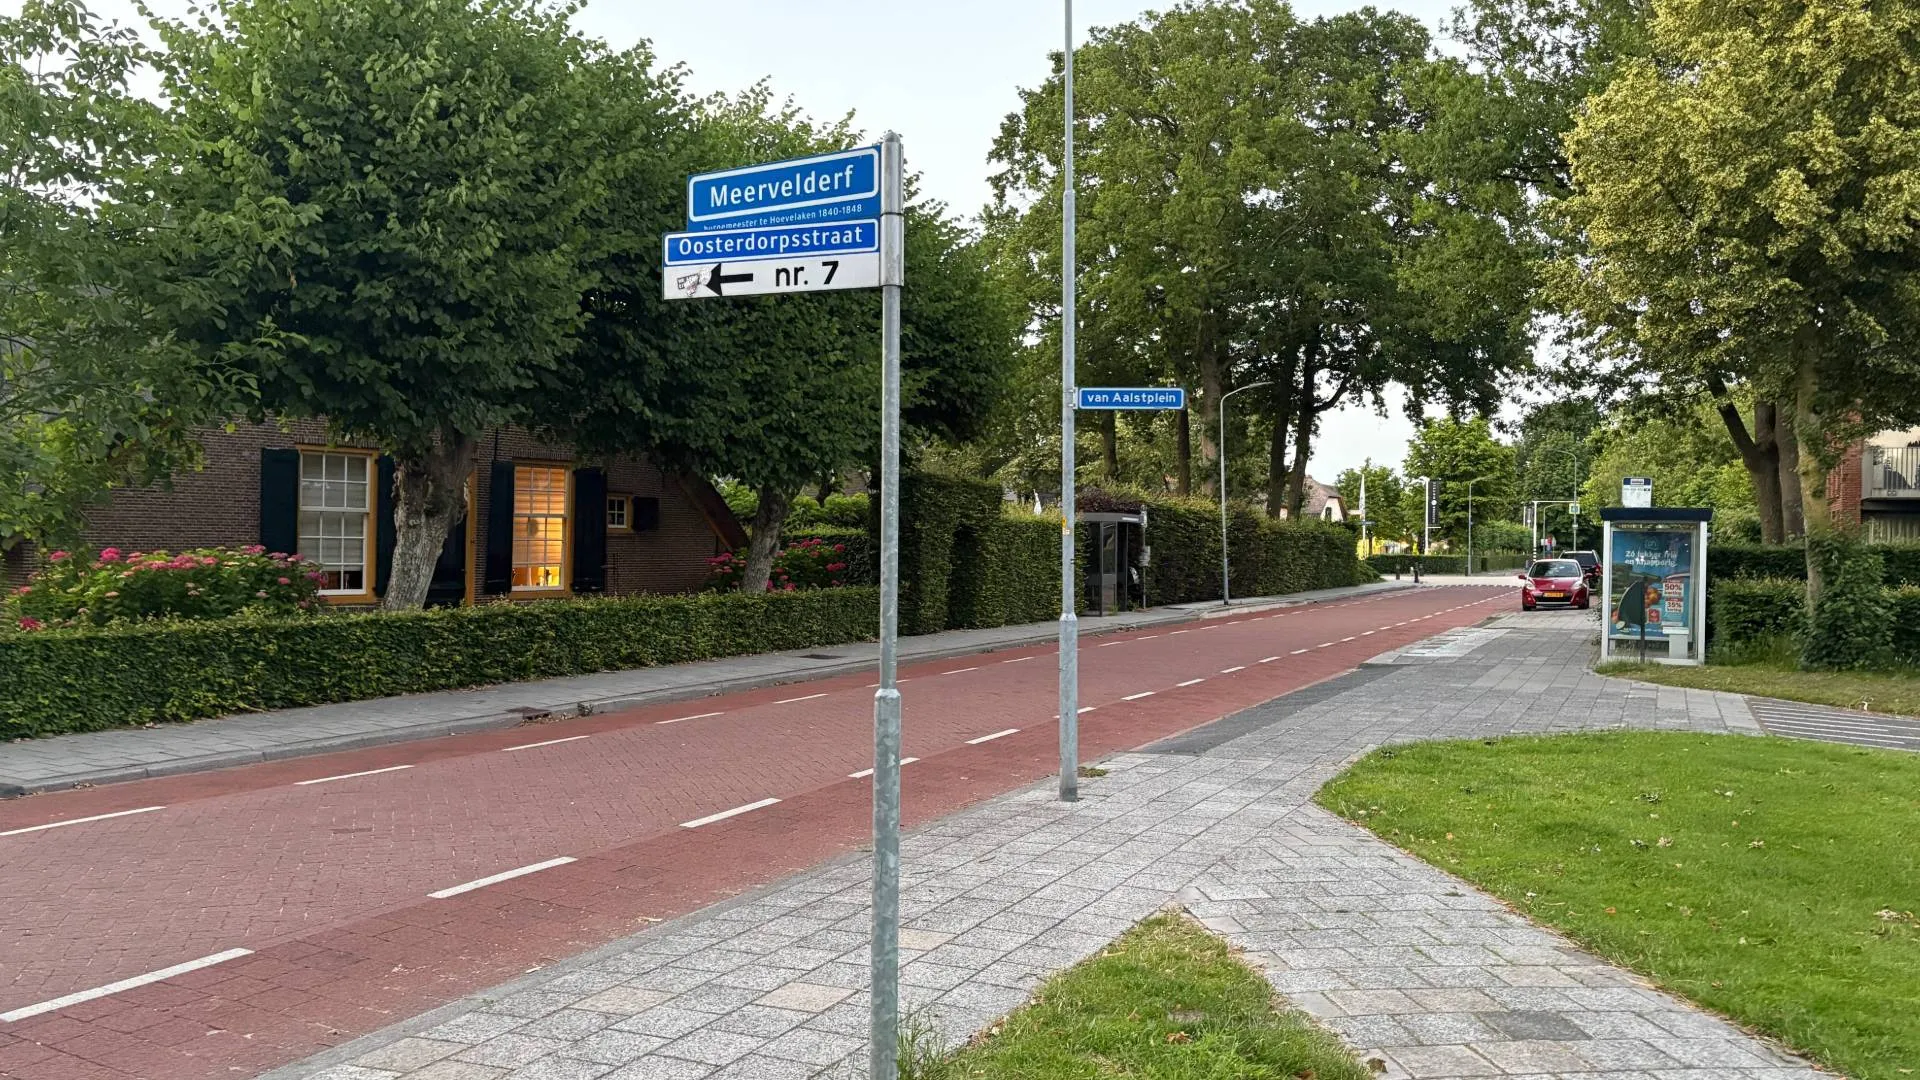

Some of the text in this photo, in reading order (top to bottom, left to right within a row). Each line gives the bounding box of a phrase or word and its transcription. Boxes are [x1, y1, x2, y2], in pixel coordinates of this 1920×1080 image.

[710, 164, 854, 208] Meervelderf
[759, 218, 768, 226] te
[769, 211, 816, 224] Hoevelaken
[818, 203, 862, 218] 1840-1848
[679, 226, 863, 255] Oosterdorpsstraat
[775, 260, 839, 287] nr. 7
[1087, 392, 1176, 404] van Aalstplein
